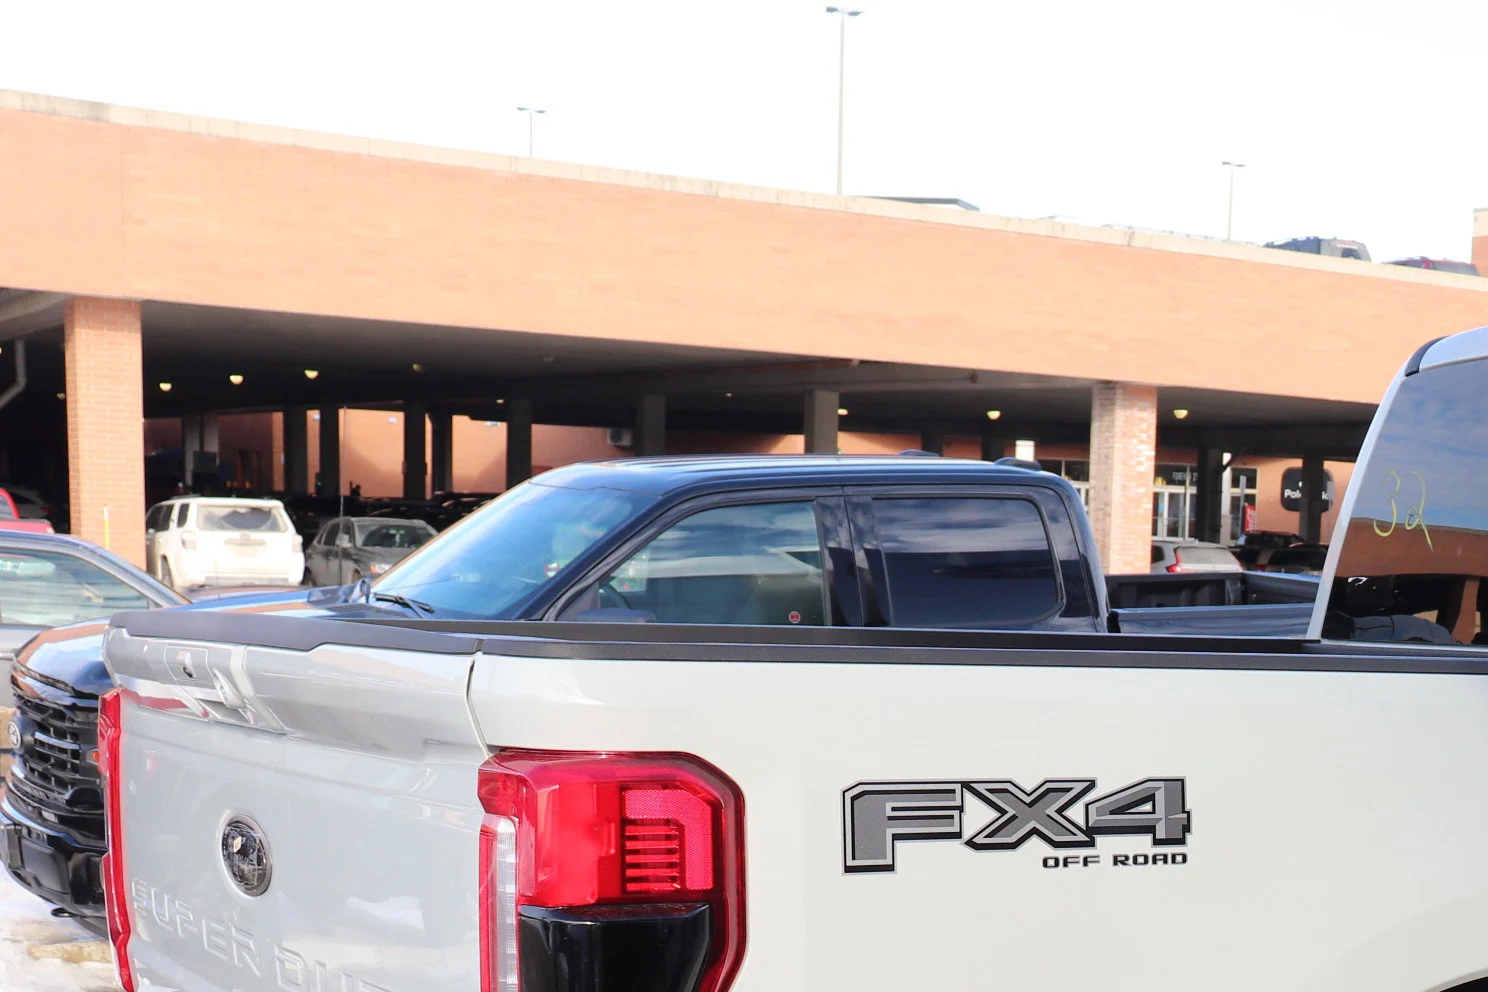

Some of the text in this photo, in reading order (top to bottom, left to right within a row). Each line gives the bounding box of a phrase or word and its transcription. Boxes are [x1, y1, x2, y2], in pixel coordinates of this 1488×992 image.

[842, 776, 1193, 874] FX4
[1042, 852, 1188, 869] OFF ROAD
[132, 878, 263, 978] SUPER
